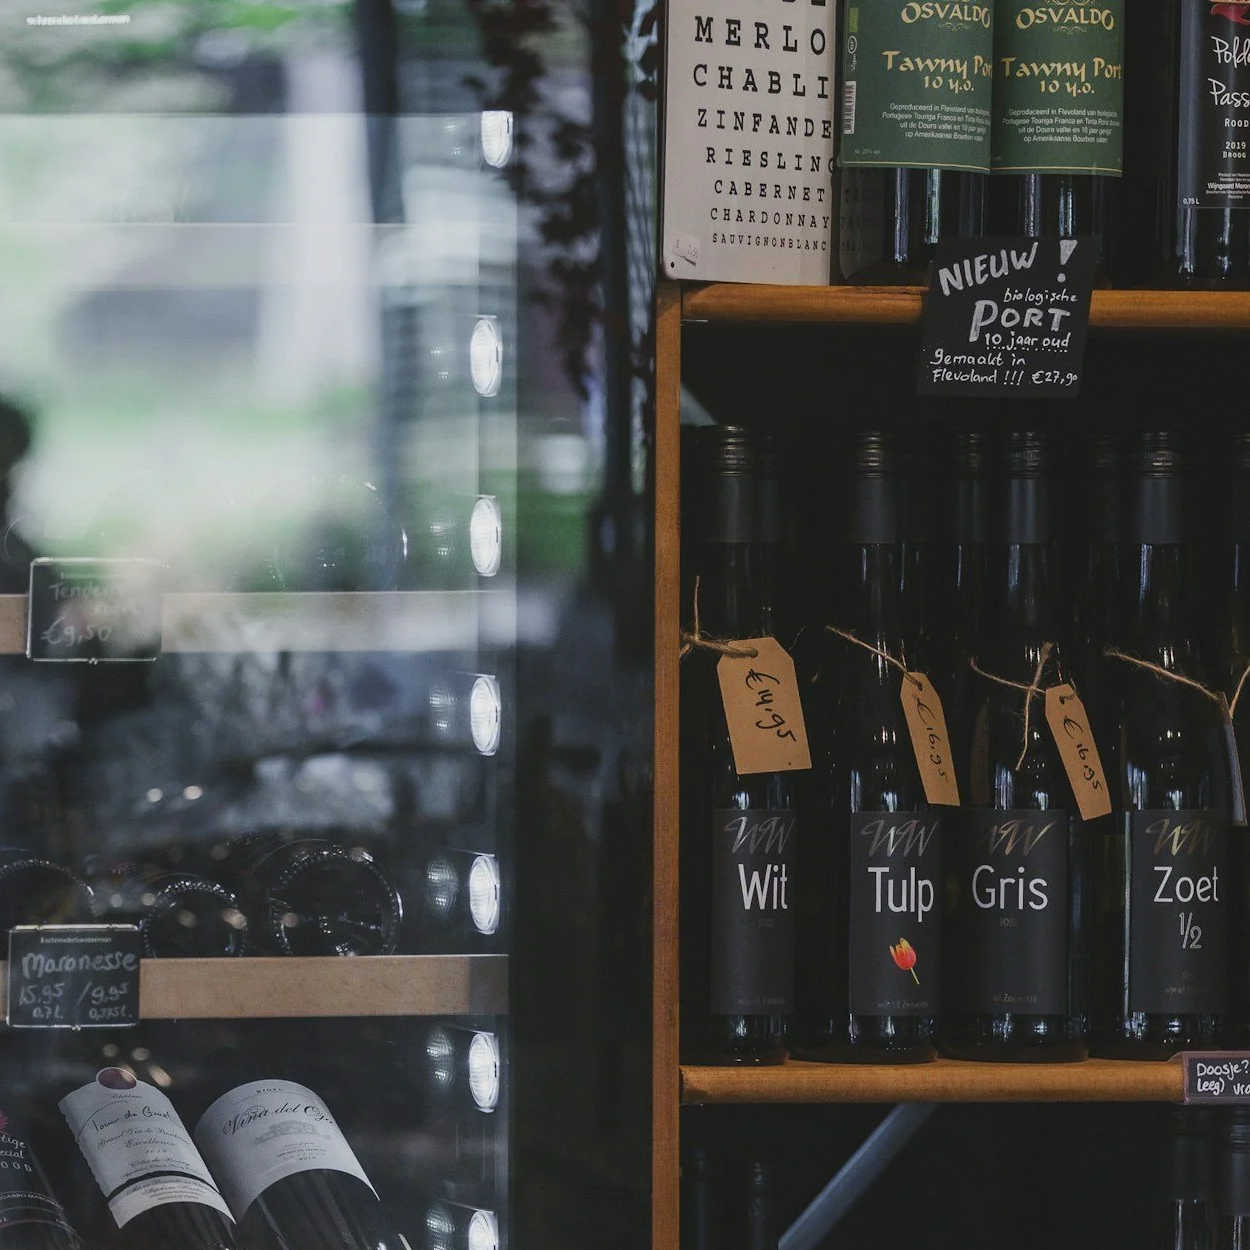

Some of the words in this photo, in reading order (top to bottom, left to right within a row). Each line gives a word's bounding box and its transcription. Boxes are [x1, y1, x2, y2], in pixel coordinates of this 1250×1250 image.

[901, 1, 991, 28] OSVALDO
[1016, 8, 1115, 30] OSVALDO
[694, 15, 827, 56] MERLO
[881, 50, 968, 79] Tawny
[1000, 57, 1086, 82] Tawny
[693, 64, 829, 99] CHABLI
[924, 76, 944, 88] 10
[1040, 80, 1060, 93] 10
[1207, 77, 1250, 107] Pass
[698, 109, 832, 139] ZINFANDE
[1225, 141, 1246, 151] 2019
[714, 179, 826, 203] CABERNET
[710, 207, 831, 230] CHARDONNAY
[712, 233, 827, 252] SAUVIGNONBLANC
[938, 242, 1039, 297] NIEUW
[1003, 287, 1078, 306] biologische
[969, 299, 1071, 343] PORT
[985, 332, 1003, 347] 10
[1005, 331, 1038, 351] jaar
[1042, 332, 1071, 348] oud
[929, 348, 1004, 367] gemaakt
[1011, 353, 1026, 367] in
[931, 366, 998, 384] Flevoland
[738, 863, 789, 911] Wit
[867, 866, 935, 924] Tulp
[971, 864, 1049, 911] Gris
[1152, 866, 1220, 903] Zoet
